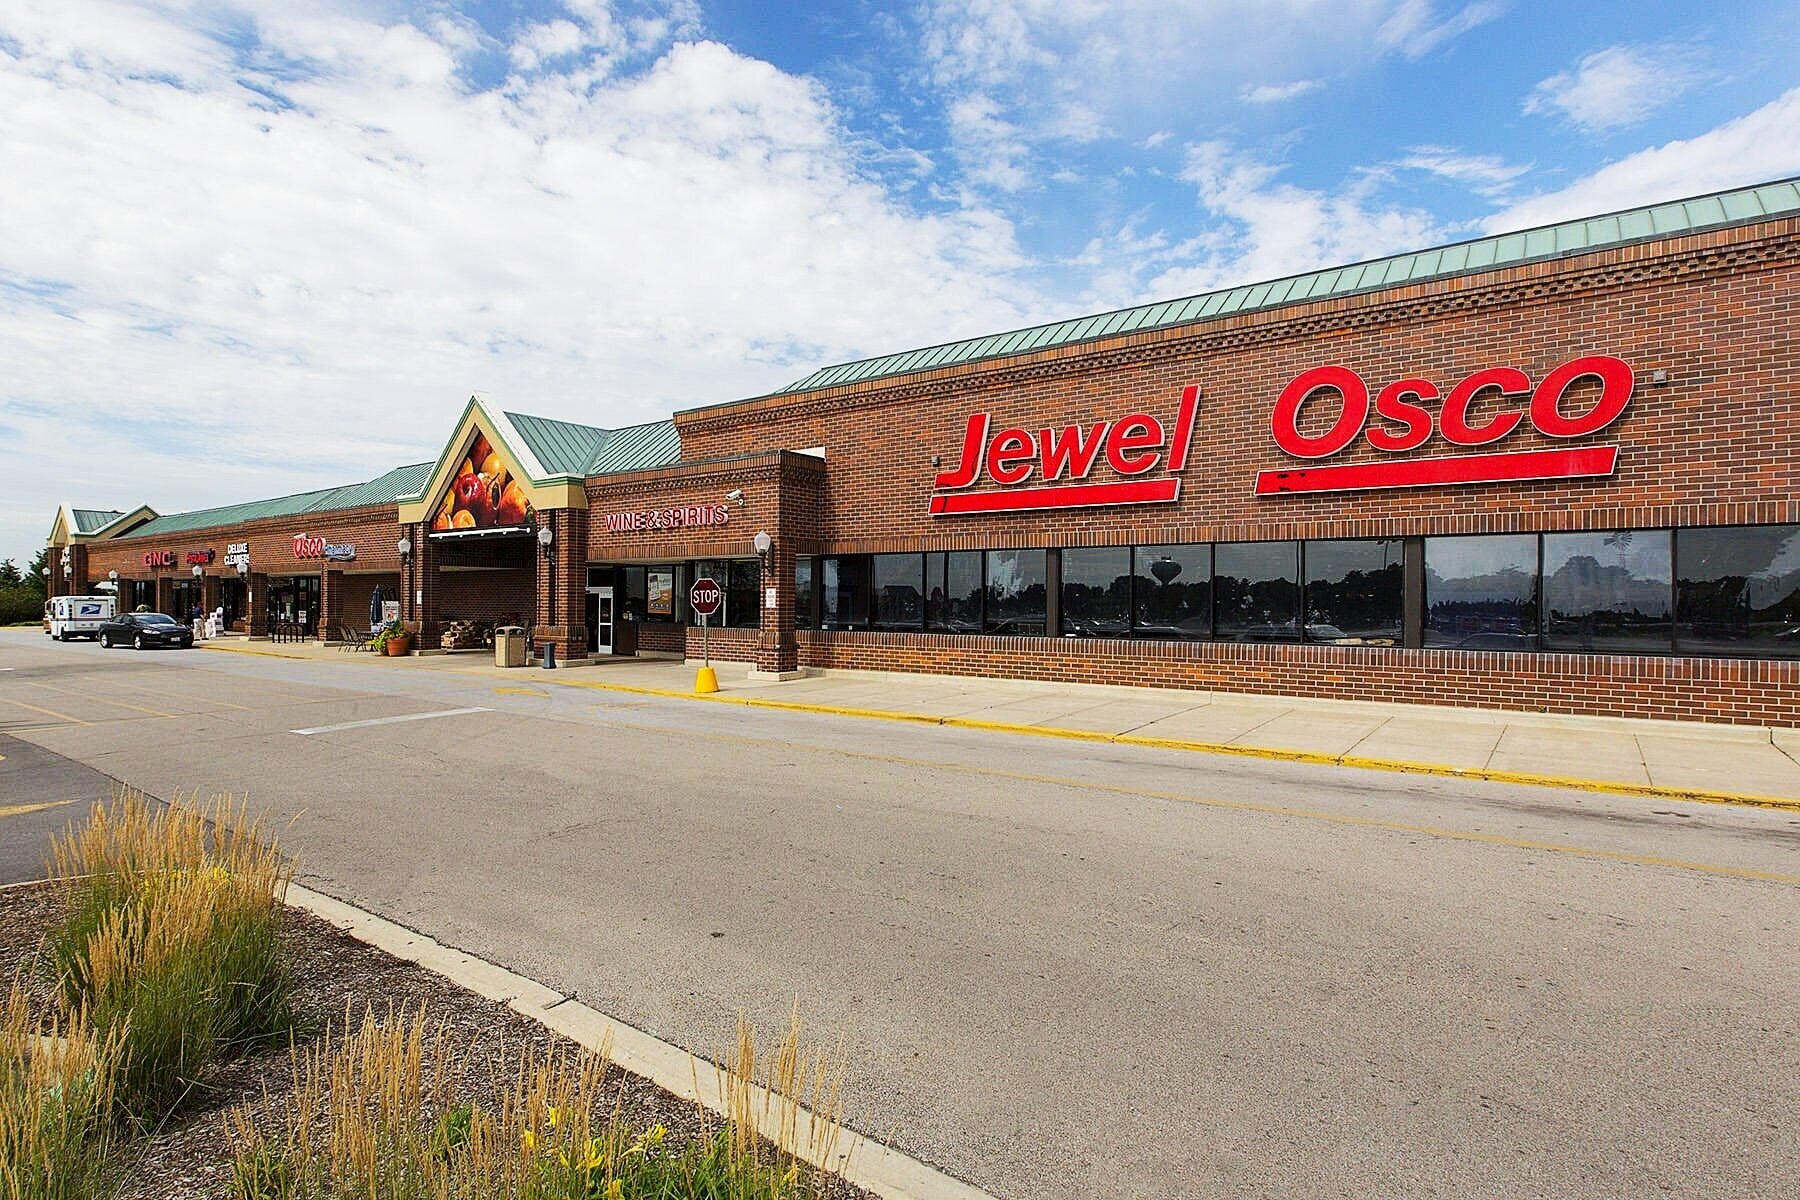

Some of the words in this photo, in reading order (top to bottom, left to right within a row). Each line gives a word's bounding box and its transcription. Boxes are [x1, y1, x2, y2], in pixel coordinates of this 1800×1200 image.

[933, 385, 1201, 489] Jewel
[1269, 355, 1635, 458] Osco
[605, 512, 643, 532] WINE
[645, 509, 660, 529] &
[661, 504, 729, 529] SPIRITS
[227, 543, 248, 554] DELUXE
[144, 551, 172, 567] GNC
[692, 589, 720, 604] STOP
